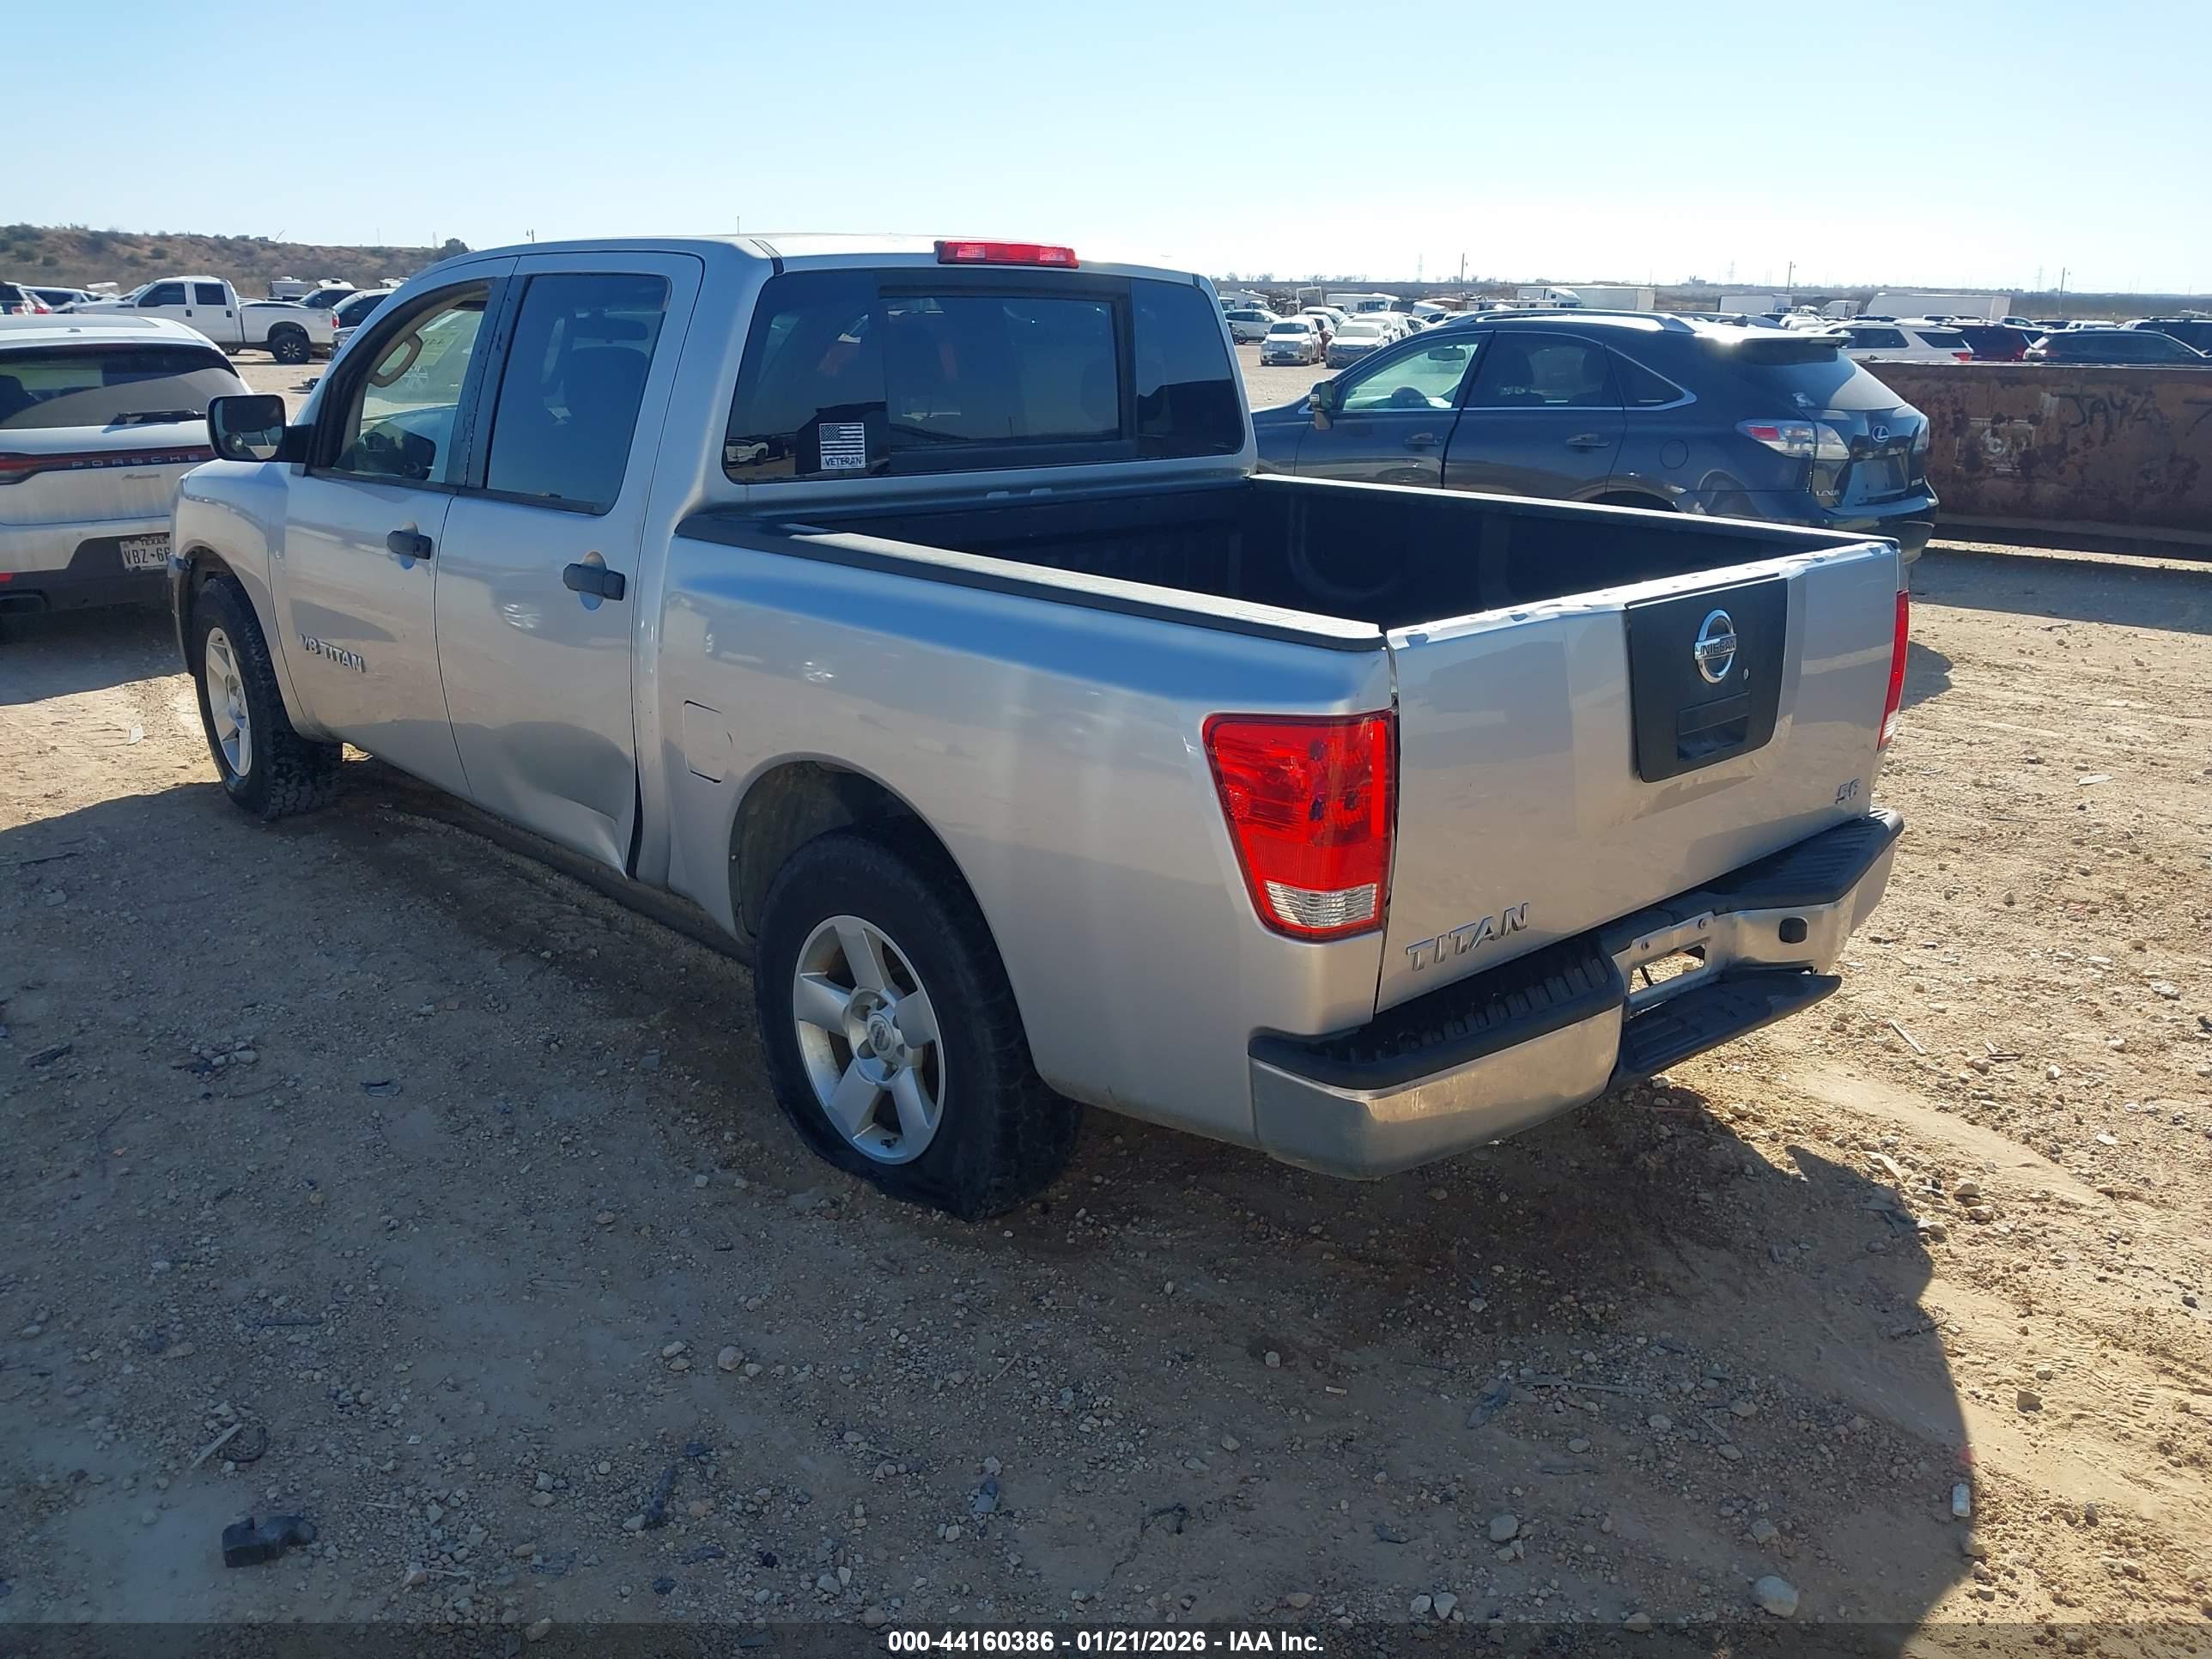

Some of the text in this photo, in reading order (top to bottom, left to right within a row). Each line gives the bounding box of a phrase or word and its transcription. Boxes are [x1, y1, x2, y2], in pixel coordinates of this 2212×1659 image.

[71, 453, 199, 468] PORSCHE
[824, 456, 863, 466] VETERAN
[139, 536, 167, 546] TEXAS
[299, 633, 366, 673] V8 TITAN
[1699, 637, 1735, 656] NISSAN
[1405, 902, 1529, 971] TITAN
